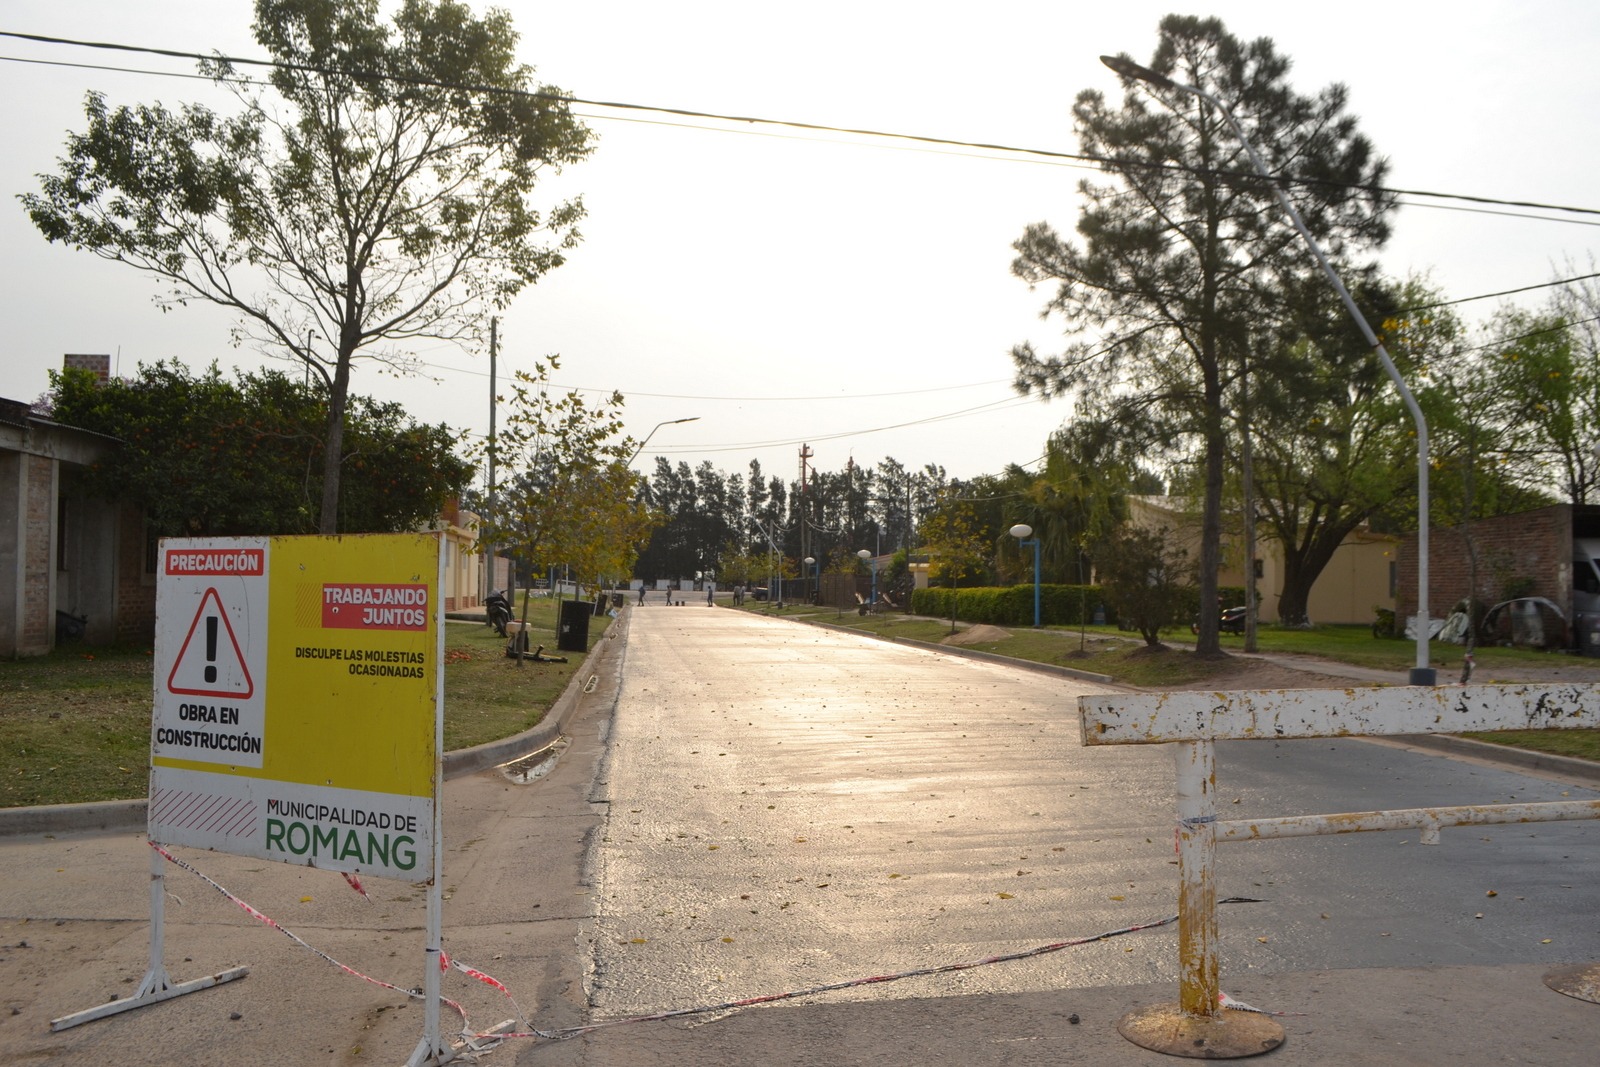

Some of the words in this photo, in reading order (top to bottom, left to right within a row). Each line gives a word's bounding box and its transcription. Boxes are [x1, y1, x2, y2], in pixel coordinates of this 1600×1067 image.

[170, 550, 258, 571] PRECAUCIÓN
[323, 587, 427, 605] TRABAJANDO
[363, 608, 425, 626] JUNTOS
[295, 647, 342, 660] DISCULPE
[344, 649, 363, 661] LAS
[365, 650, 425, 664] MOLESTIAS
[349, 663, 424, 679] OCASIONADAS
[179, 703, 217, 723] OBRA
[220, 707, 239, 725] EN
[157, 728, 261, 754] CONSTRUCCIÓN
[267, 799, 391, 829] MUNICIPALIDAD
[394, 815, 416, 832] DE
[266, 818, 416, 871] ROMANG
